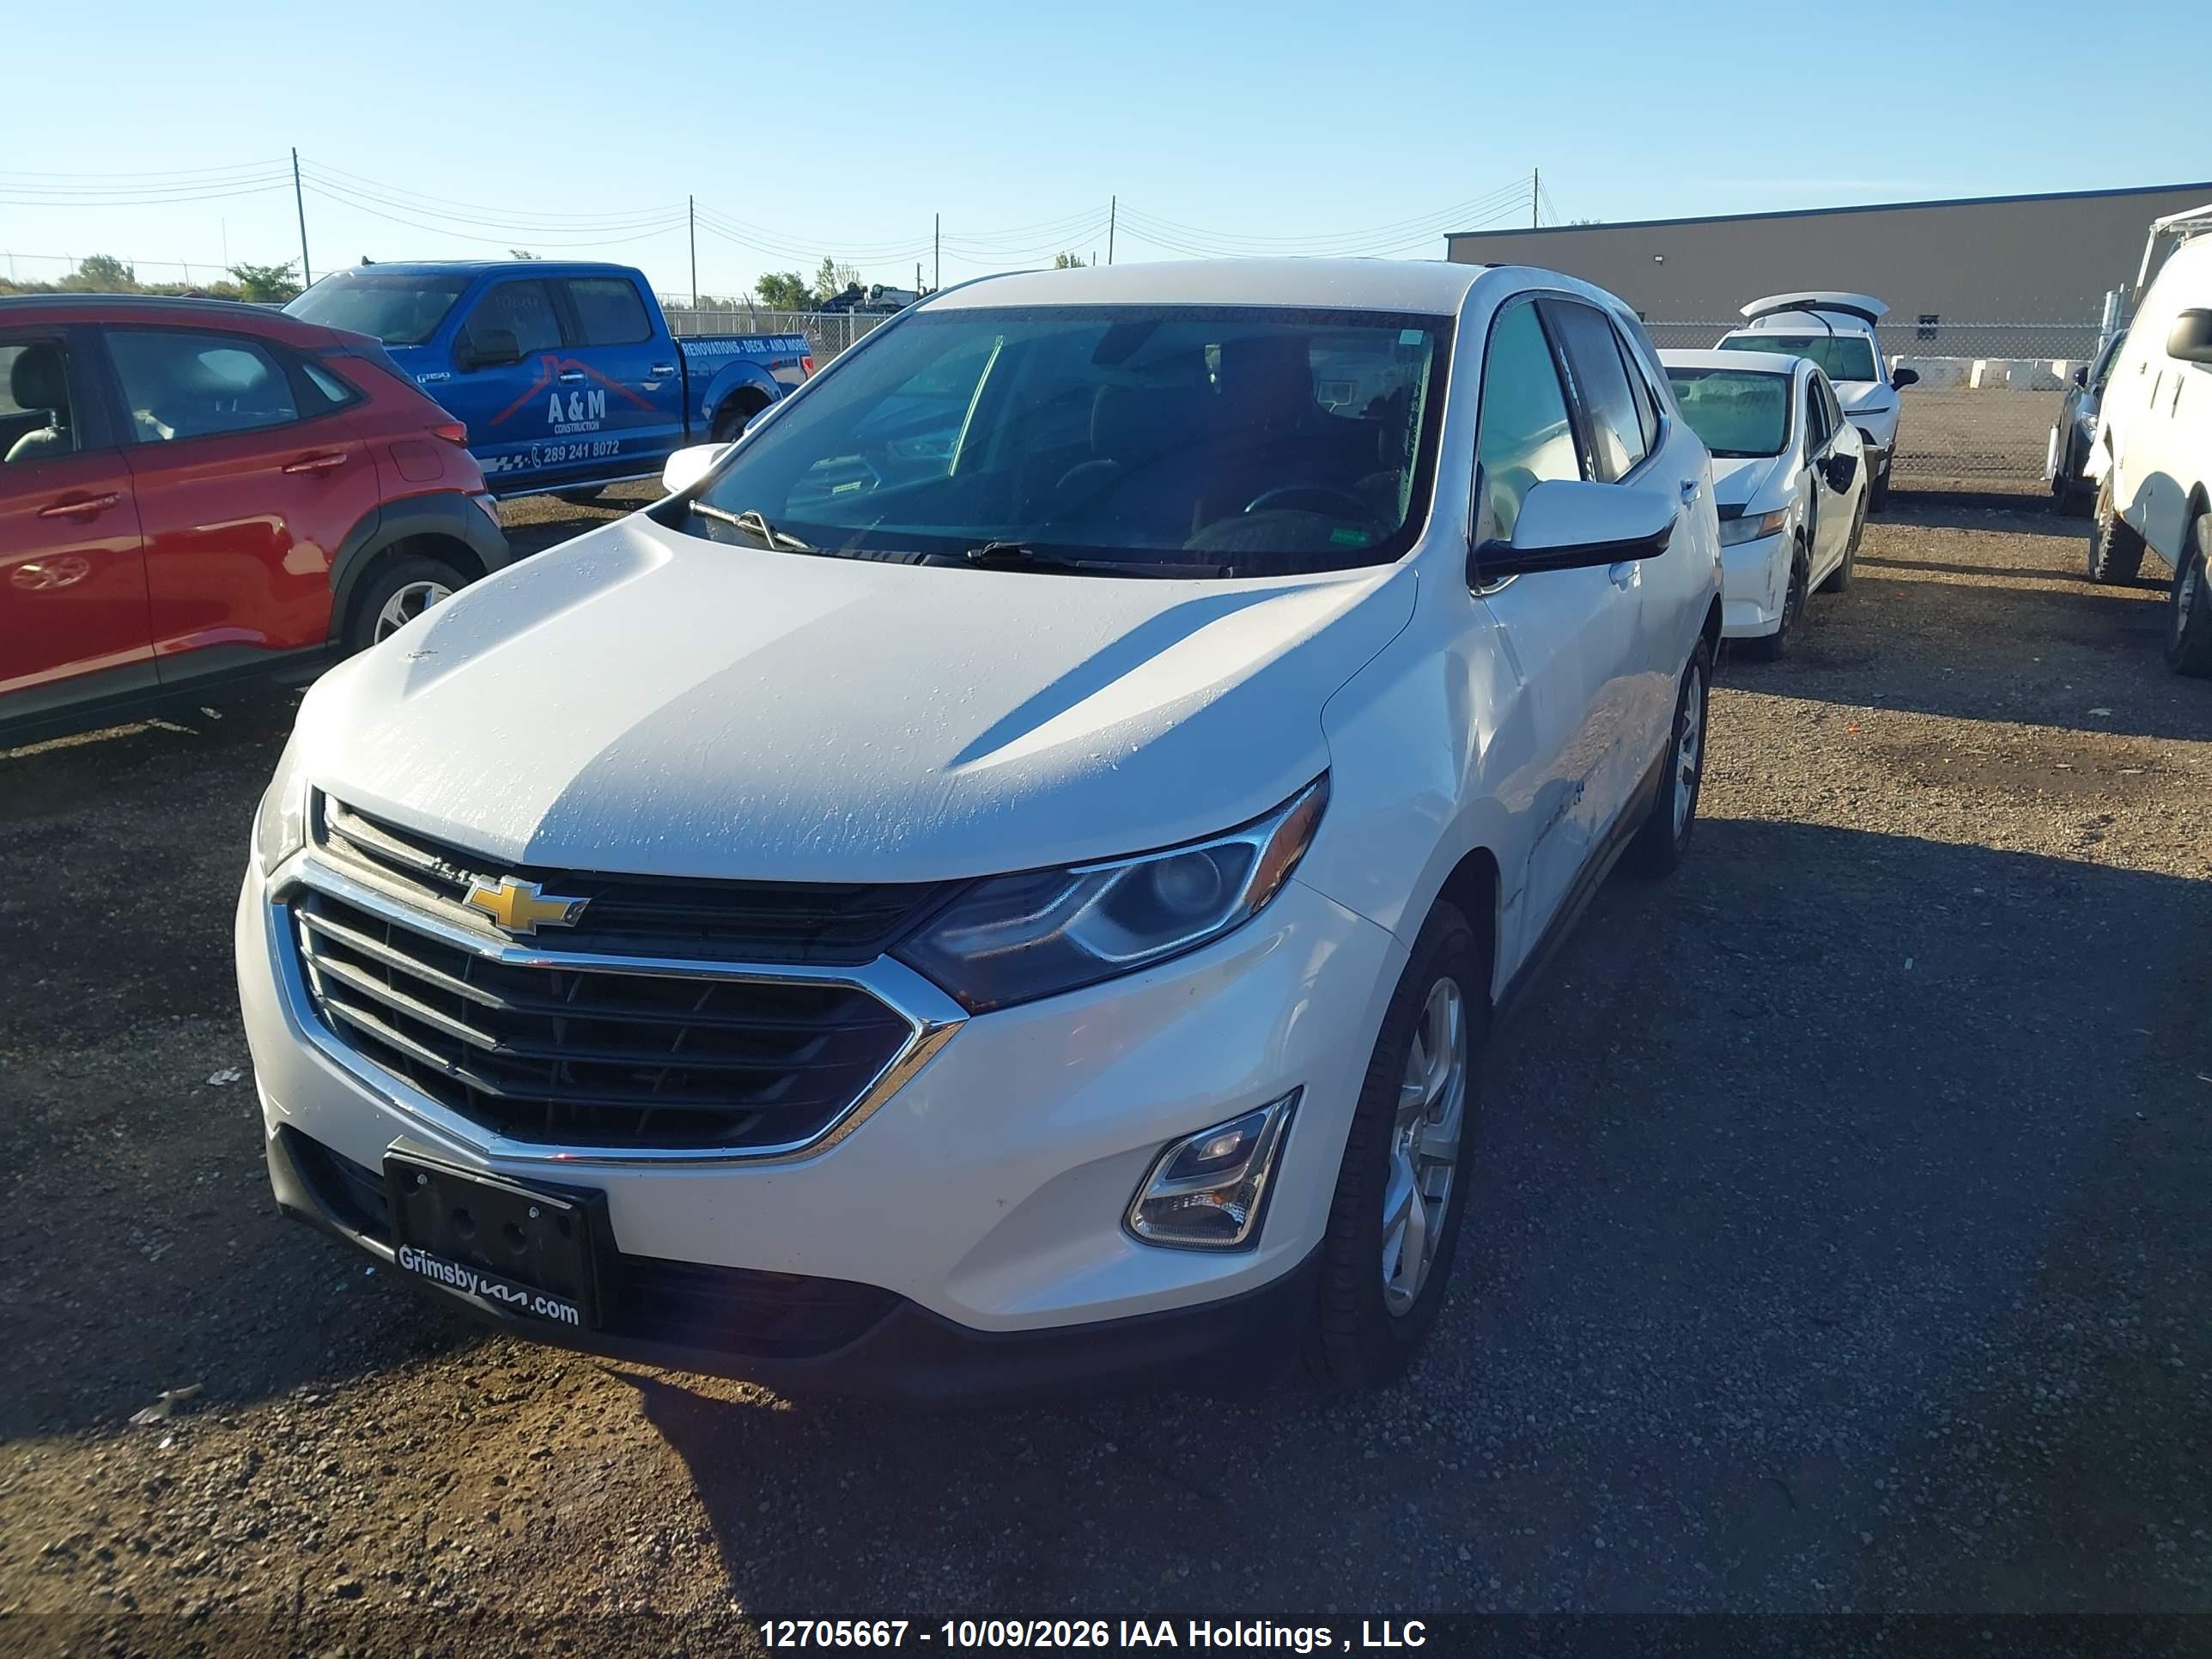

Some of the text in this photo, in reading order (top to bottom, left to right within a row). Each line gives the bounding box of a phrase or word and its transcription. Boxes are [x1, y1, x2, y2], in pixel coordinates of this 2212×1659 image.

[682, 340, 740, 356] RENOVATIONS
[744, 339, 767, 353] DECK
[769, 338, 787, 352] AND
[786, 337, 808, 350] MORE
[548, 390, 605, 423] A & M
[554, 421, 599, 434] CONSTRUCTION
[544, 440, 619, 463] 289 241 8072
